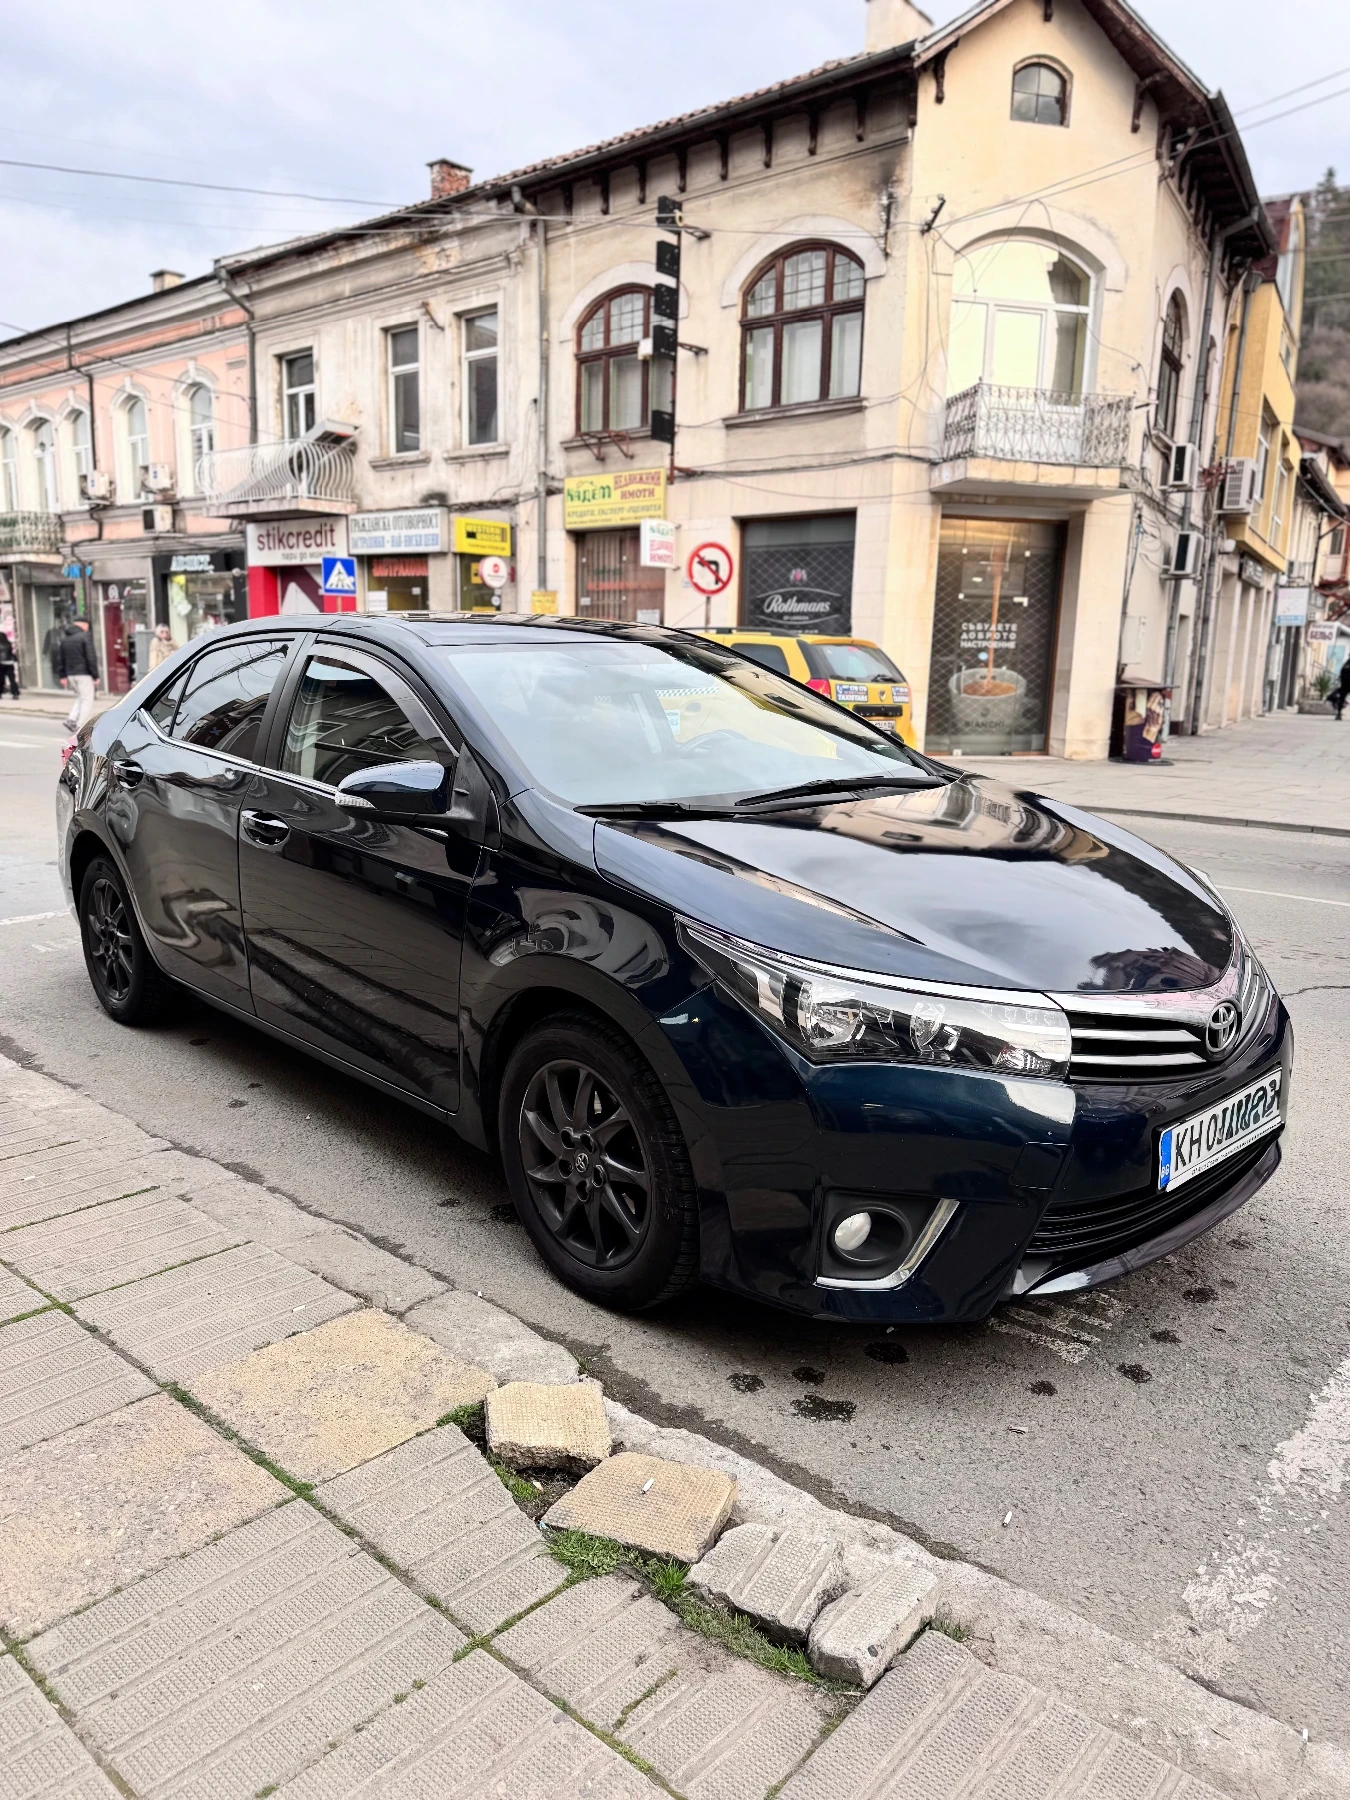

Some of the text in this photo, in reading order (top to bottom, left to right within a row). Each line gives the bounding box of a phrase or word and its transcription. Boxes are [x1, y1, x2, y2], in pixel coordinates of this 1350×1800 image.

[620, 488, 655, 500] ИМОТИ
[392, 513, 439, 530] ОТГОВОРНОСТ
[257, 523, 336, 550] stikcredit
[763, 594, 831, 613] Rothmans
[960, 632, 1017, 640] ДОБРОТО
[960, 640, 1016, 649] НАСТРОЕНИЕ
